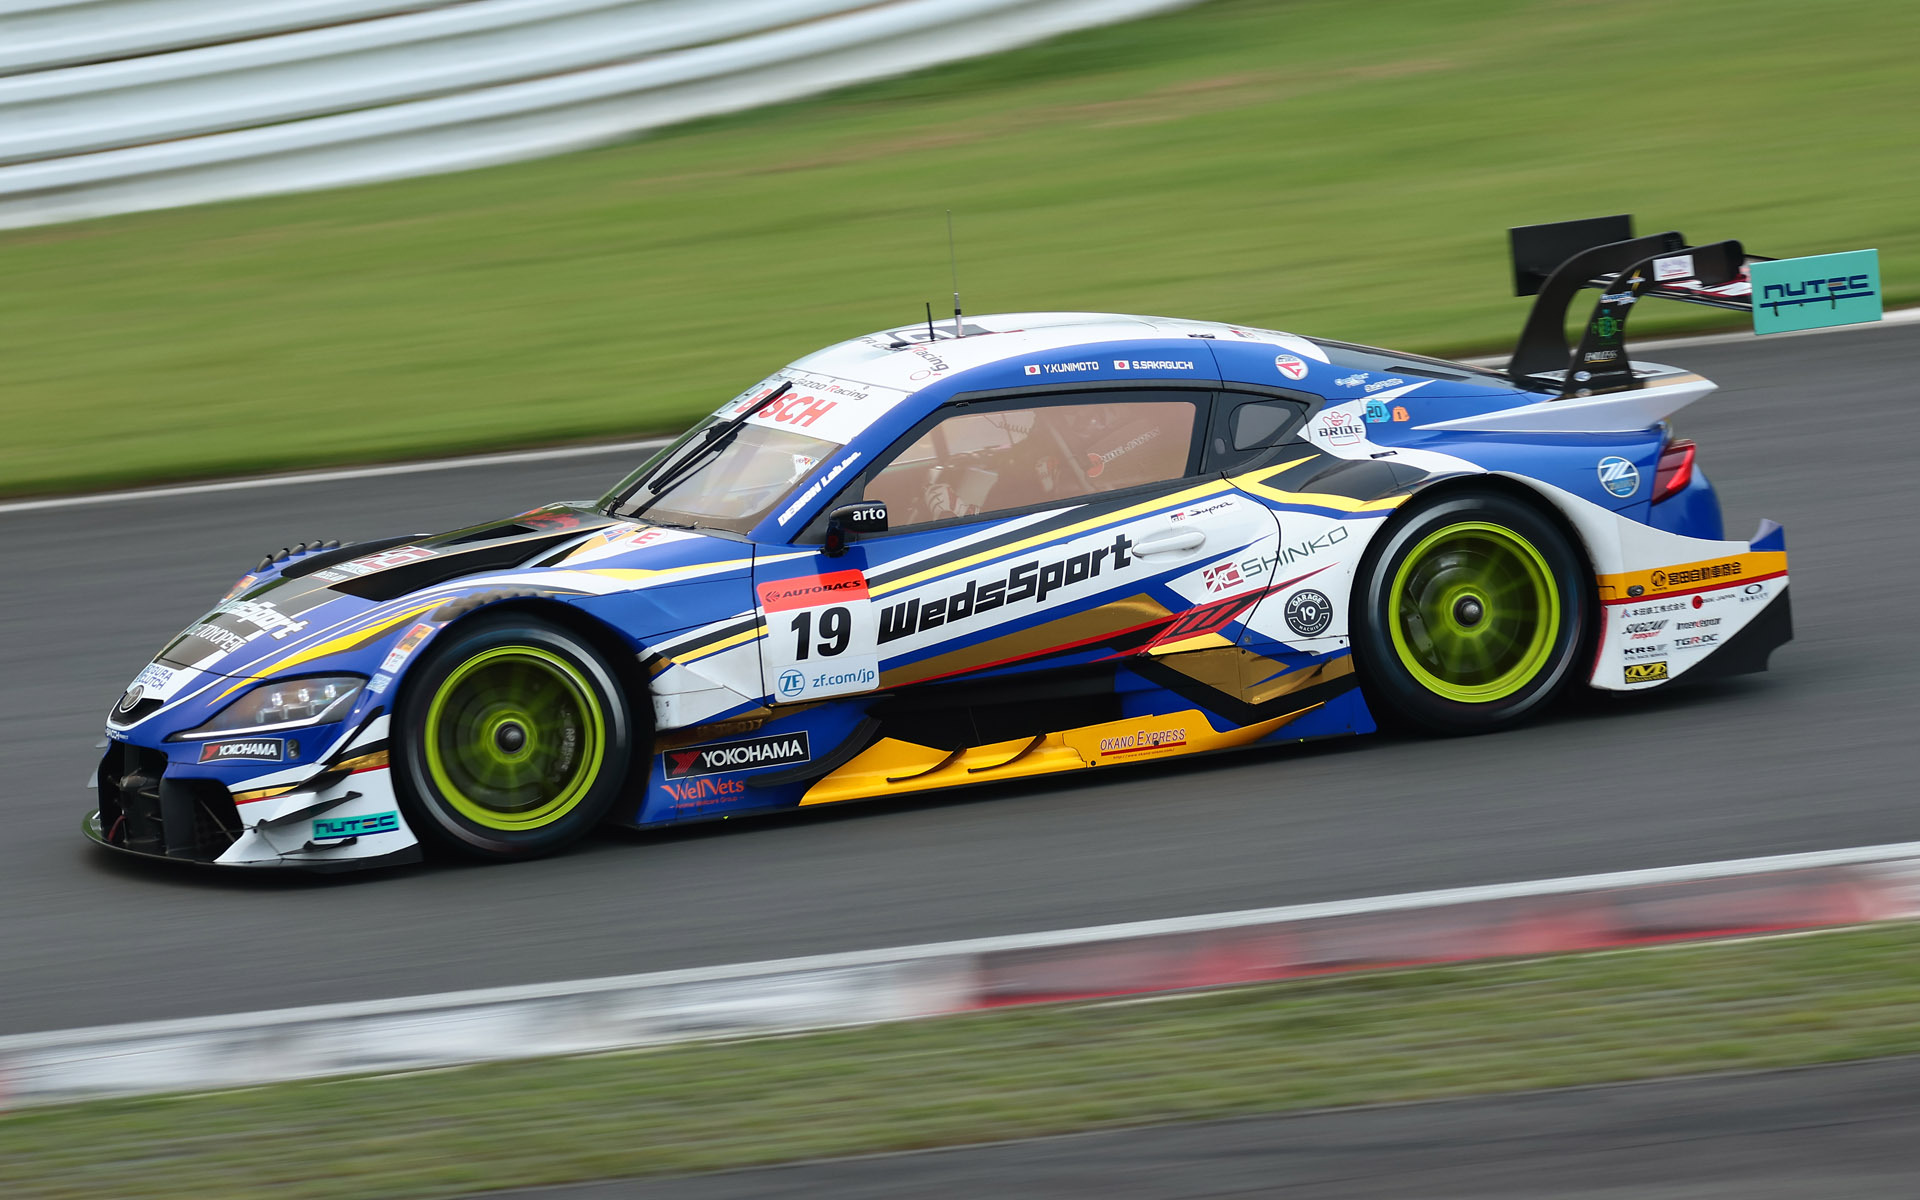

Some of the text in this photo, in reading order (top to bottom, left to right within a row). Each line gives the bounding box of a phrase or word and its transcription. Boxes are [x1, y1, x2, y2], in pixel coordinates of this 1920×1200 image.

[1043, 361, 1099, 373] Y.KUNIMOTO
[1132, 360, 1194, 370] S.SAKAGUCHI
[734, 388, 838, 427] BSCH
[1367, 406, 1382, 418] 20
[1318, 425, 1364, 437] BRIDE
[777, 481, 822, 527] DESIGN
[1187, 501, 1235, 516] Supra
[852, 505, 886, 521] arto
[1241, 526, 1349, 578] SHINKO
[782, 579, 862, 599] AUTOBACS
[877, 533, 1133, 645] WedsSport
[1292, 594, 1322, 606] GARAGE
[1300, 606, 1316, 621] 19
[790, 607, 852, 661] 19
[1299, 623, 1322, 631] MACHIDA
[1674, 634, 1718, 646] TGR-DC
[1624, 646, 1655, 654] KRS
[781, 675, 803, 692] ZF
[812, 668, 876, 689] zf.com/jp
[218, 743, 277, 756] YOKOHAMA
[1100, 737, 1134, 750] OKANO
[701, 739, 803, 768] YOKOHAMA
